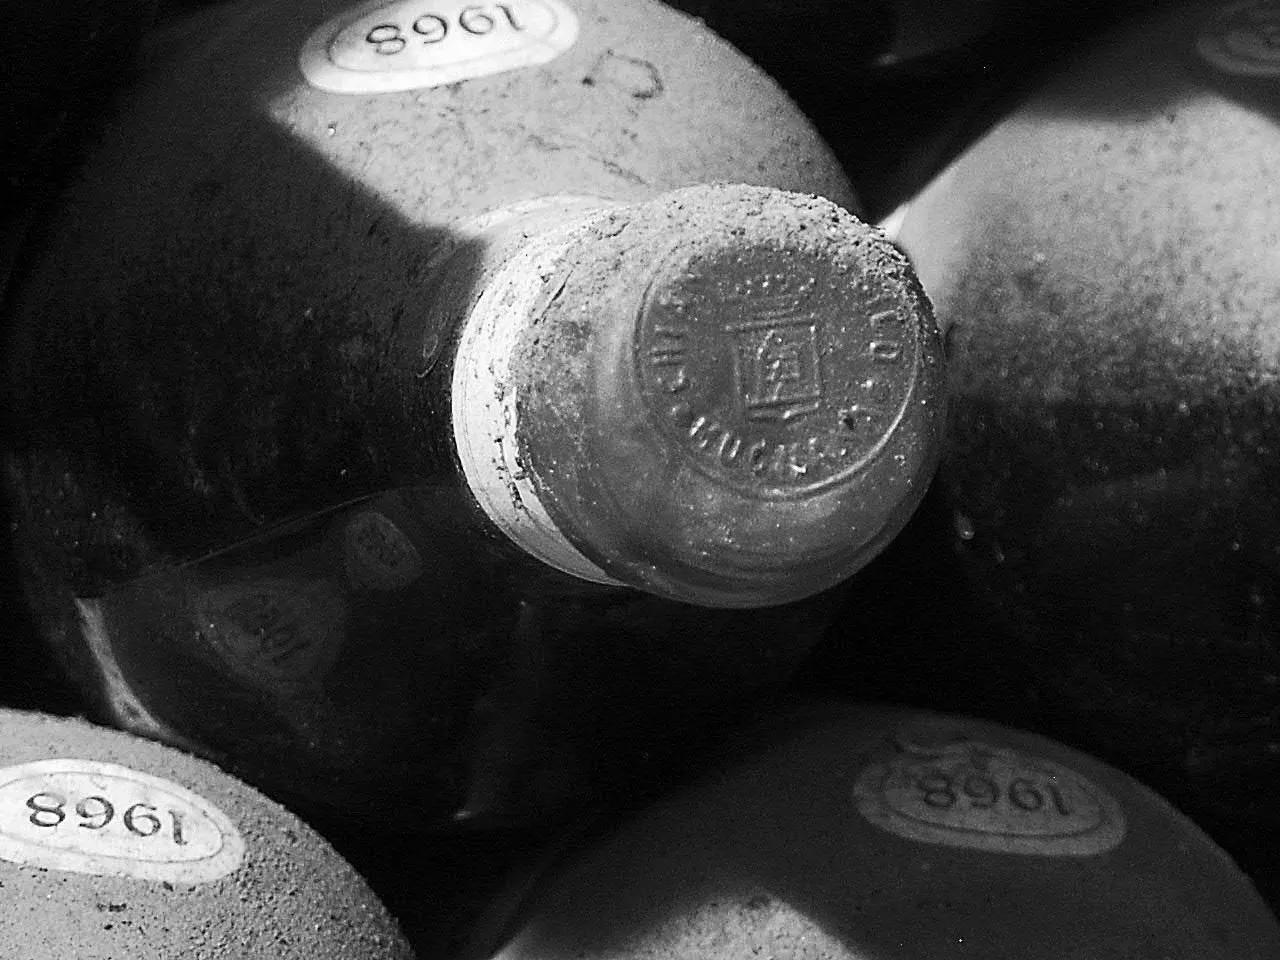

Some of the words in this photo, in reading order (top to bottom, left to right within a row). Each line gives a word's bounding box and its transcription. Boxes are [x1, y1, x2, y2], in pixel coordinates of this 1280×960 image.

[364, 4, 527, 56] 1968
[26, 792, 188, 846] 1968
[917, 771, 1069, 816] 1968
